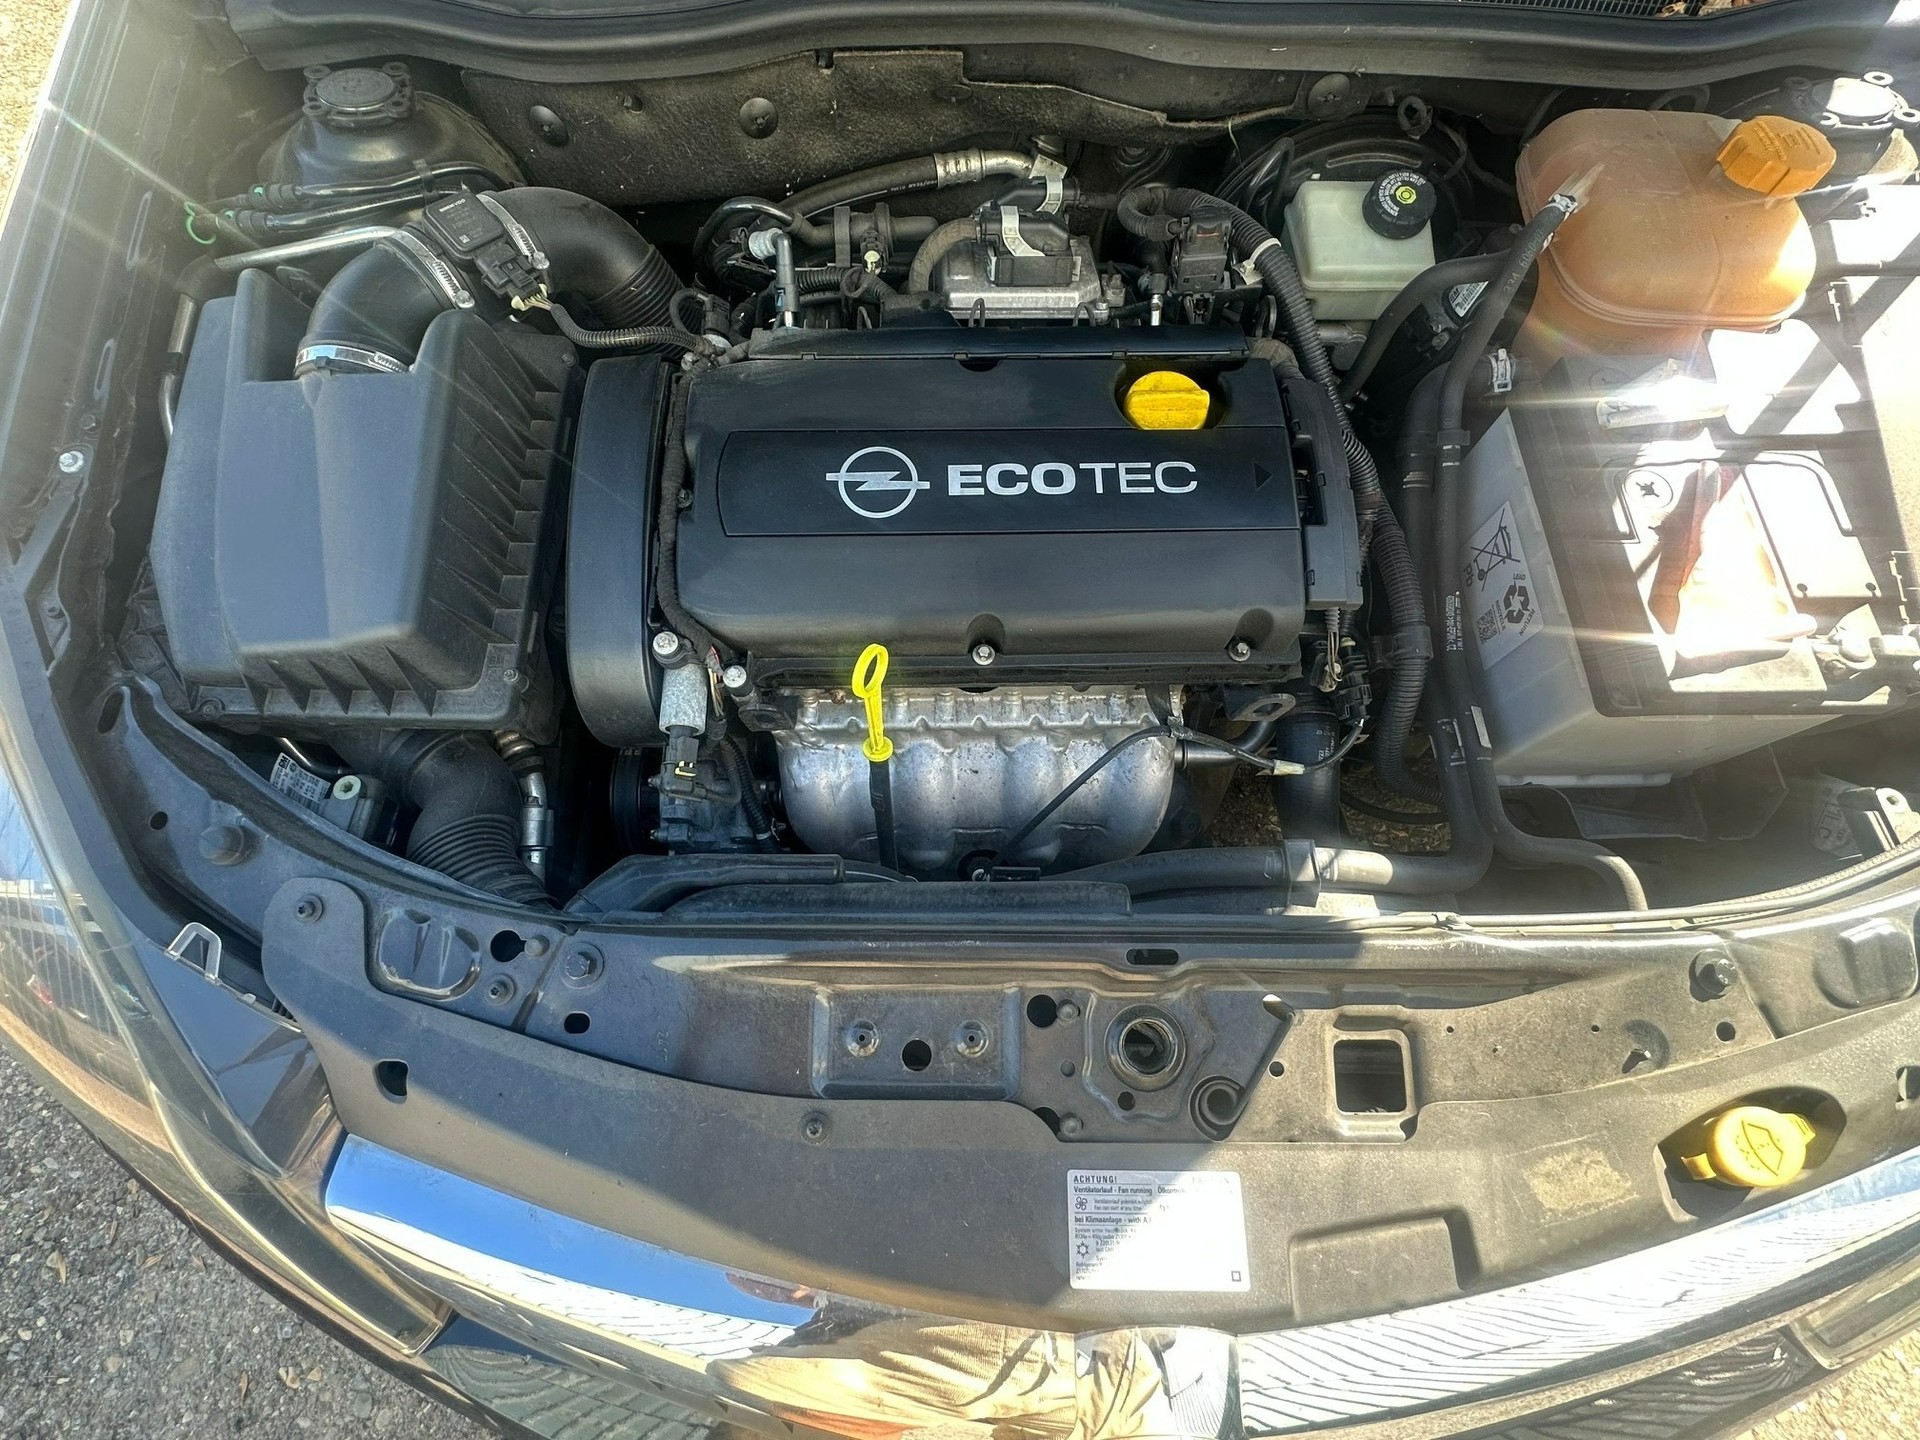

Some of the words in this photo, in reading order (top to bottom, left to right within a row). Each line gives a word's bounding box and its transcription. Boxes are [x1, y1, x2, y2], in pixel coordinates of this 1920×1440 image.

[947, 461, 1198, 496] ECOTEC
[1463, 563, 1474, 587] Pb
[1513, 573, 1526, 581] LEAD
[1495, 599, 1507, 631] RECYCLE
[1519, 608, 1536, 637] RETURN
[278, 755, 290, 770] GM
[1073, 1175, 1117, 1184] ACHTUNG!
[1130, 1187, 1153, 1195] running
[1074, 1215, 1084, 1223] bei
[1085, 1216, 1122, 1224] Klimaanlage
